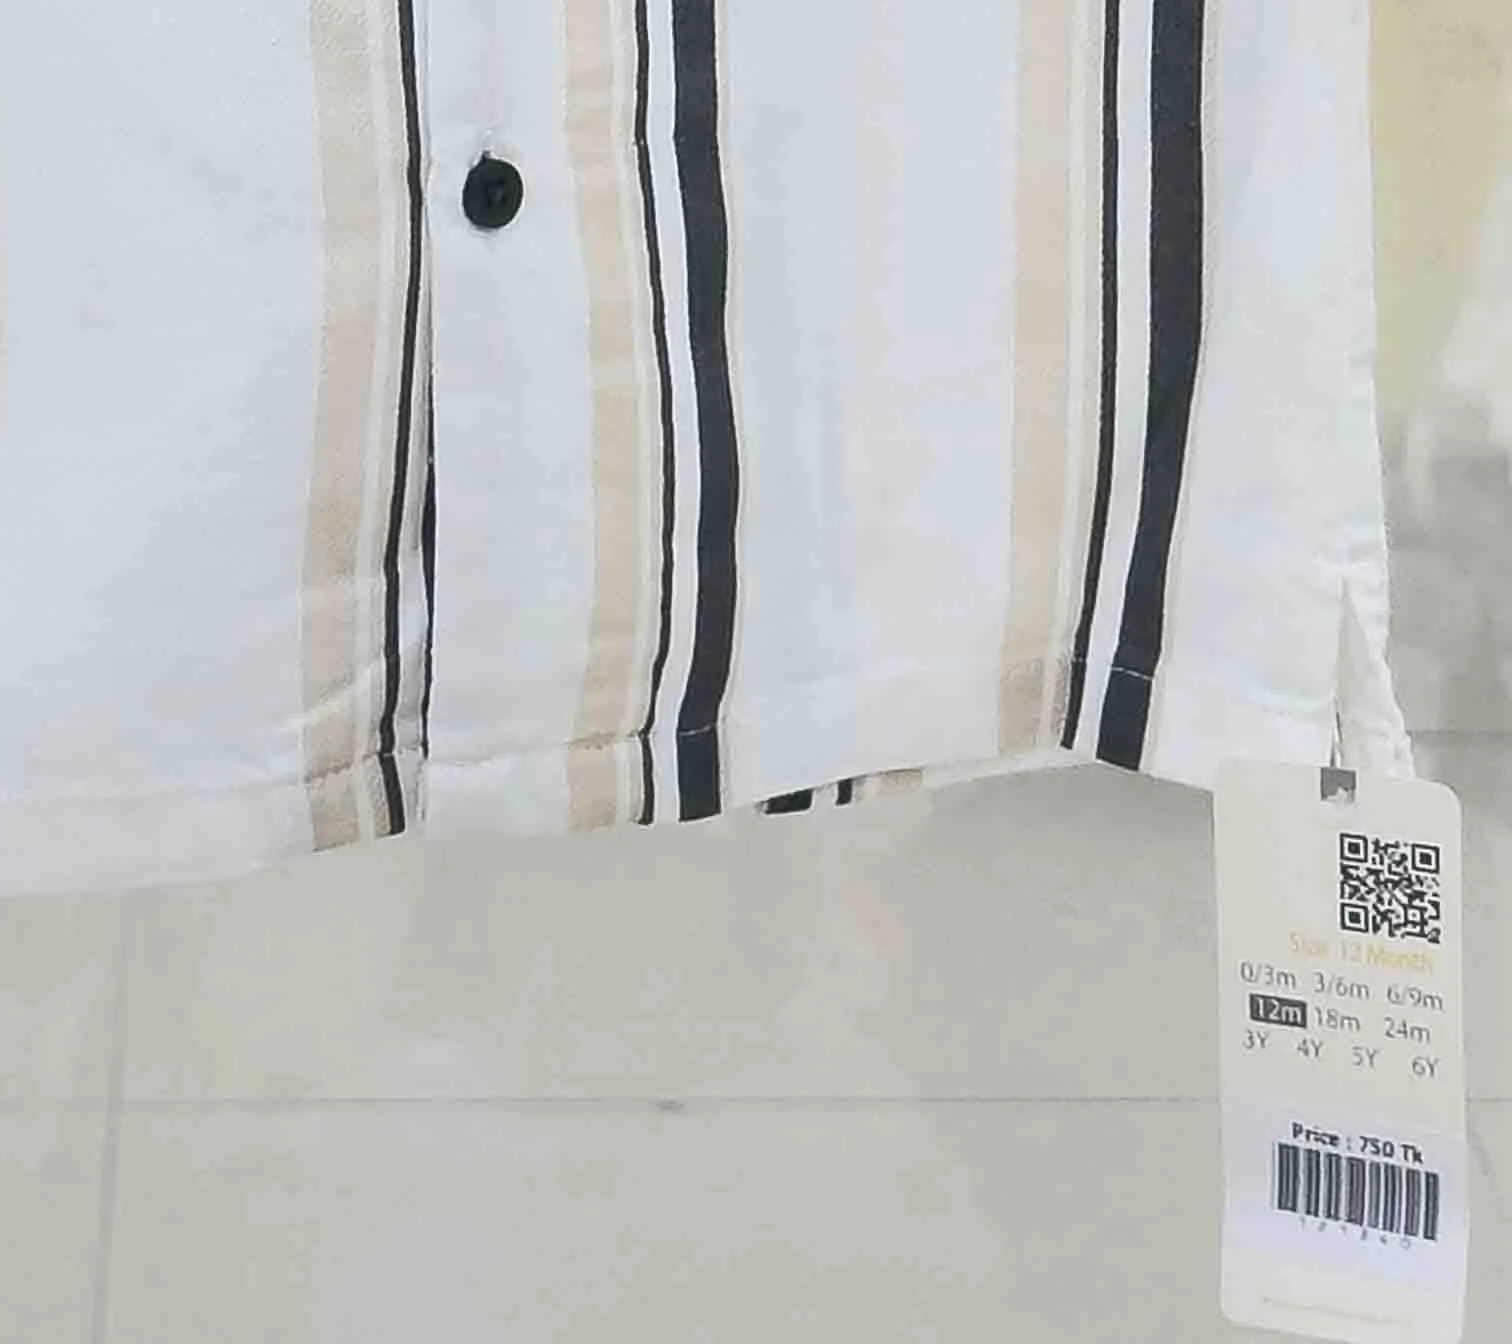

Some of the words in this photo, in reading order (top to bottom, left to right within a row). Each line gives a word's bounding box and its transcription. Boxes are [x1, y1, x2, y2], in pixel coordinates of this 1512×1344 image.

[1240, 961, 1296, 989] 0/3m
[1312, 972, 1369, 999] 3/6m
[1387, 984, 1443, 1011] 6/9m
[1254, 996, 1302, 1024] 12m
[1315, 1006, 1361, 1032] 18m
[1384, 1017, 1431, 1043] 24m
[1243, 1030, 1269, 1049] 3Y
[1297, 1038, 1323, 1058] 4Y
[1352, 1046, 1379, 1068] 5Y
[1412, 1056, 1440, 1078] 6Y
[1292, 1121, 1340, 1148] Price
[1360, 1135, 1395, 1158] 750
